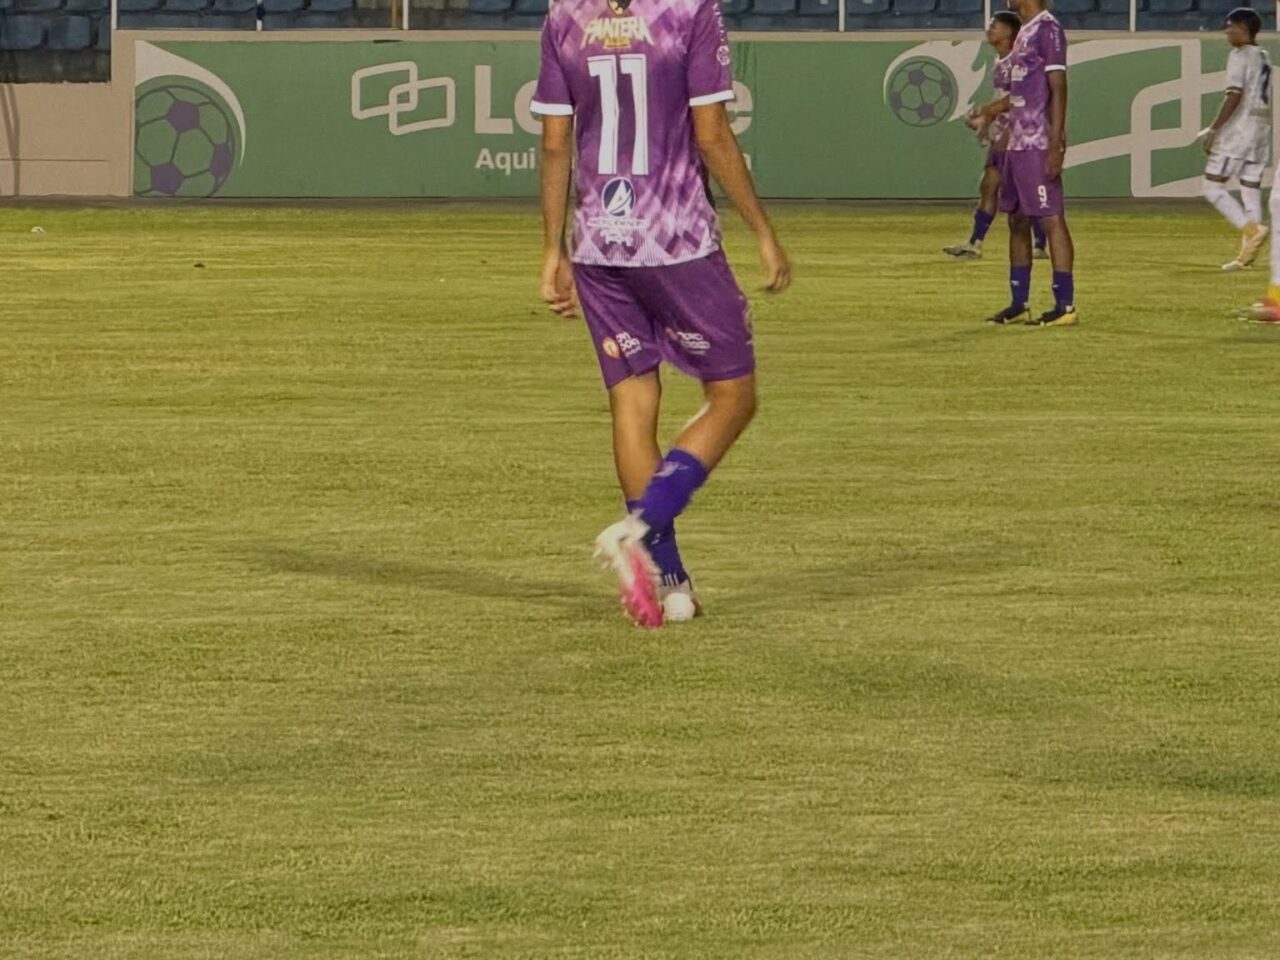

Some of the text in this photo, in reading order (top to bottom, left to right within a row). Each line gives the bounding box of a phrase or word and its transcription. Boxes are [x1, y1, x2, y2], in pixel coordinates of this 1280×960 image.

[579, 15, 655, 50] PANTERA
[587, 53, 649, 176] 11
[475, 147, 536, 176] Aqui
[1037, 184, 1048, 203] 9
